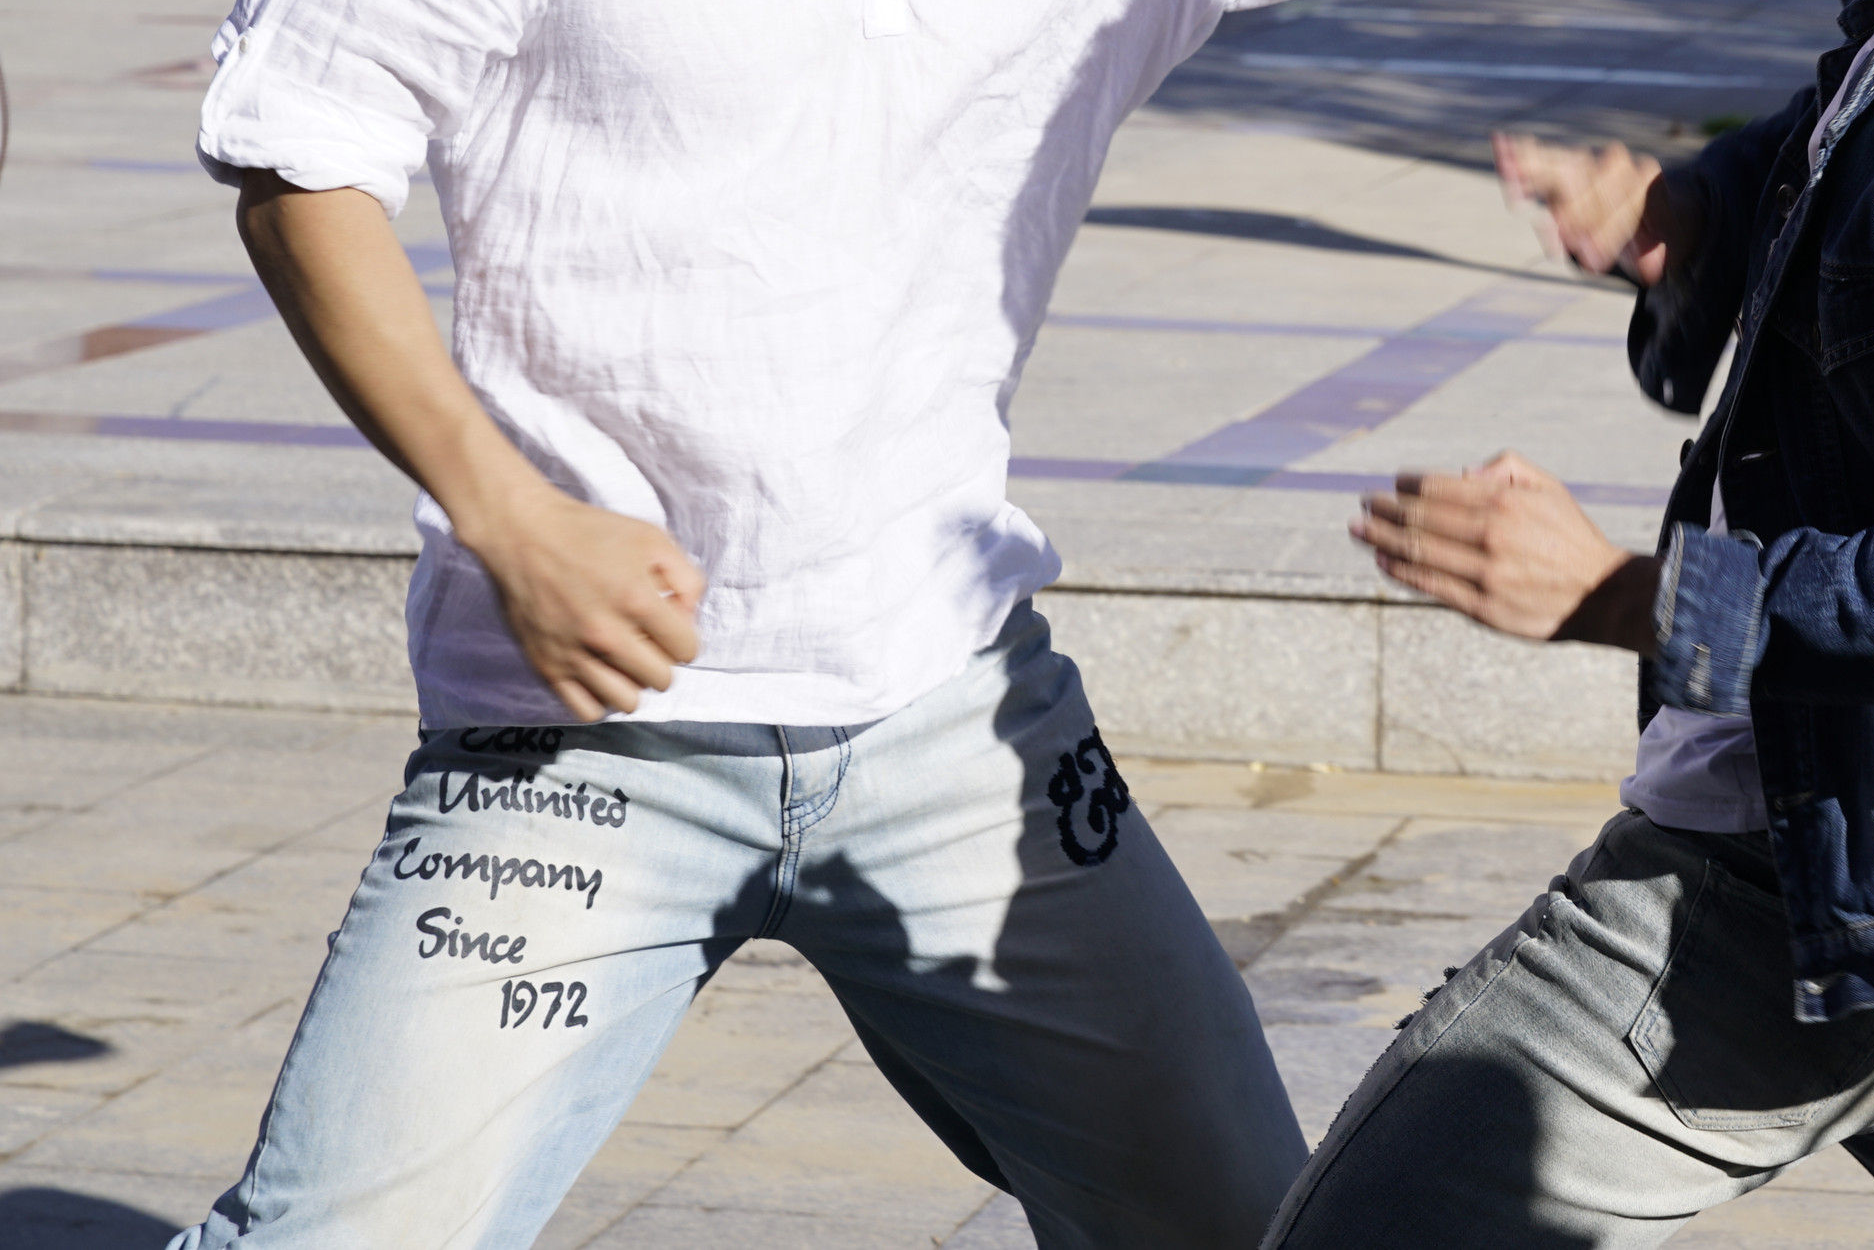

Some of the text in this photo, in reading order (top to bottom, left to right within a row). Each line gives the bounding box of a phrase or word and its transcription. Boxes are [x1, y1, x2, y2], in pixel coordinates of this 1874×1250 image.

[393, 837, 603, 910] Company
[416, 907, 527, 964] Since
[500, 980, 589, 1030] 1972
